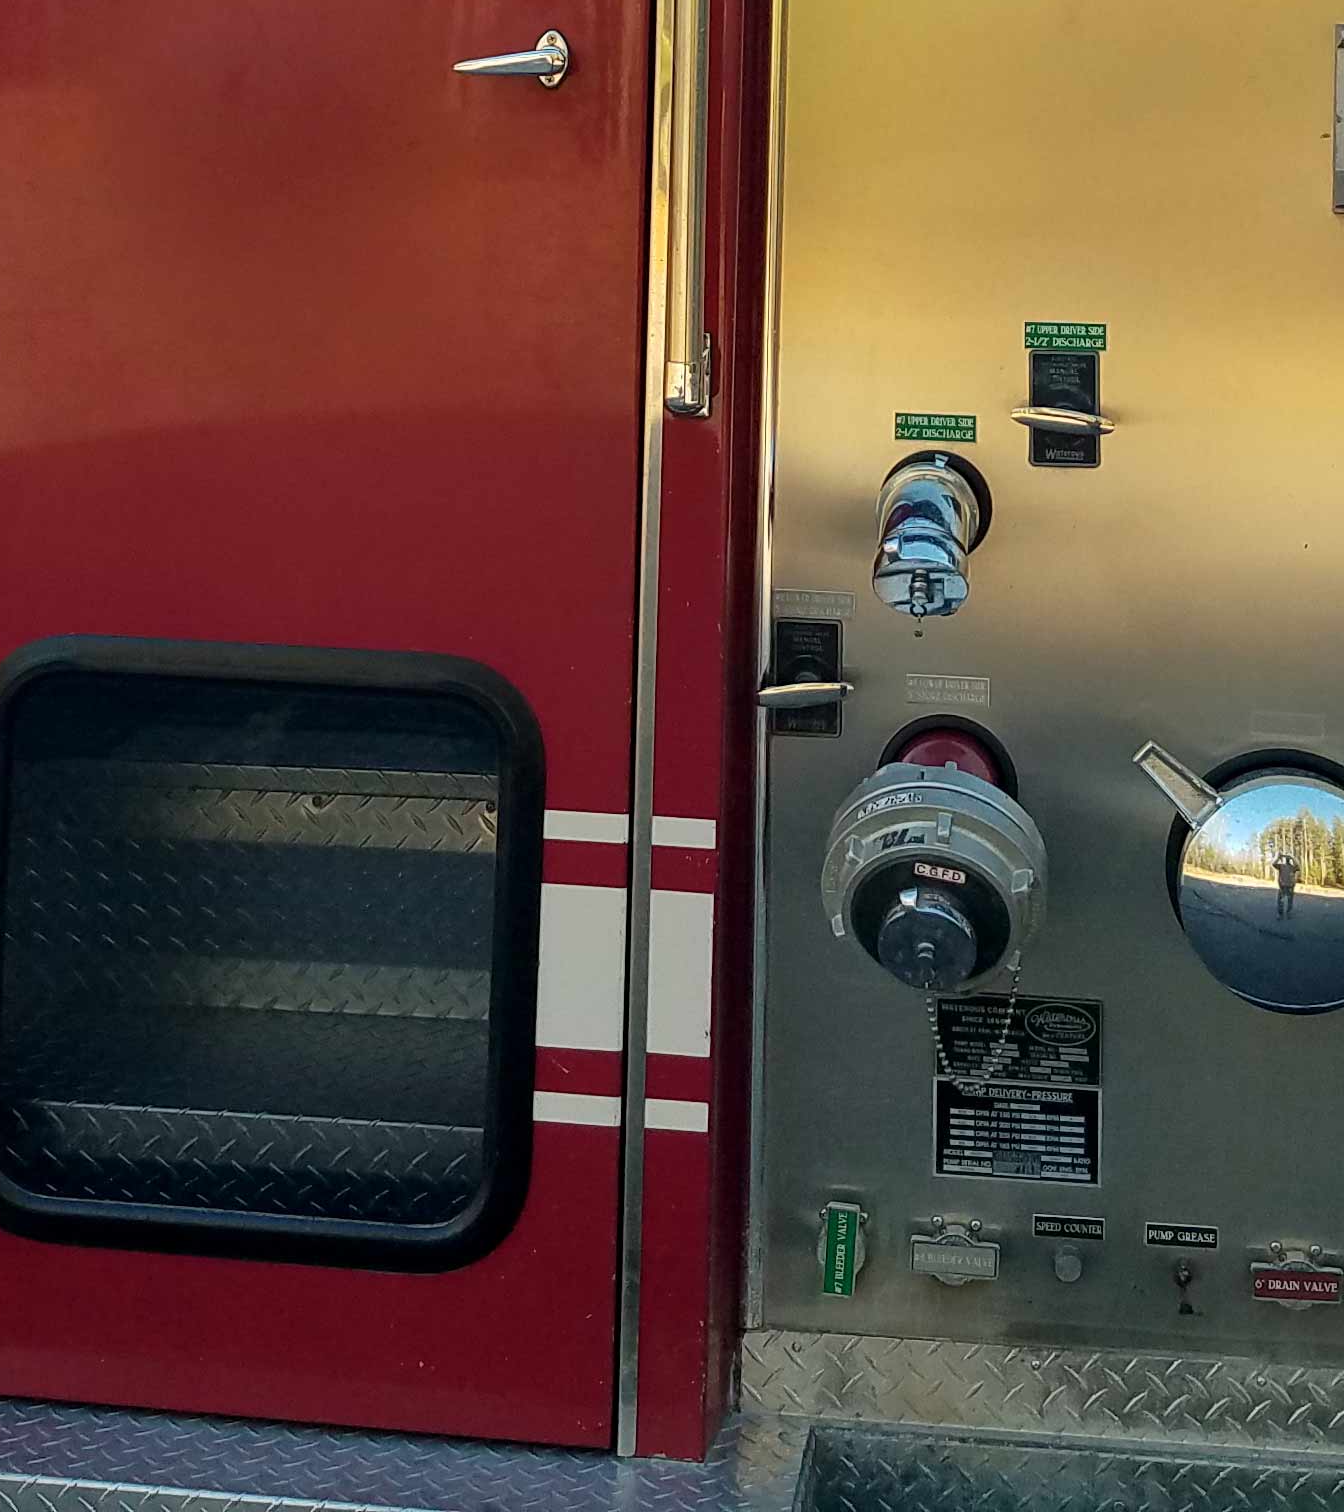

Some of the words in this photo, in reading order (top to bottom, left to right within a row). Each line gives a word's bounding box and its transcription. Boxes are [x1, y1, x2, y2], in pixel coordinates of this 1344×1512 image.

[1037, 325, 1058, 334] UPPER
[1060, 326, 1086, 335] DRIVER
[1088, 326, 1104, 335] SIDE
[1052, 337, 1104, 348] DISCHARGE
[908, 416, 928, 425] UPPER
[930, 417, 956, 426] DRIVER
[958, 418, 974, 427] SIDE
[922, 428, 974, 439] DISCHARGE
[917, 864, 963, 882] C.G.F.D.
[837, 1212, 847, 1241] VALVE
[1036, 1222, 1061, 1231] SPEED
[1063, 1224, 1102, 1234] COUNTER
[1148, 1230, 1174, 1240] PUMP
[1177, 1232, 1215, 1243] GREASE
[835, 1244, 846, 1280] BLEEDER
[1268, 1279, 1300, 1290] DRAIN
[1303, 1281, 1338, 1292] VALVE
